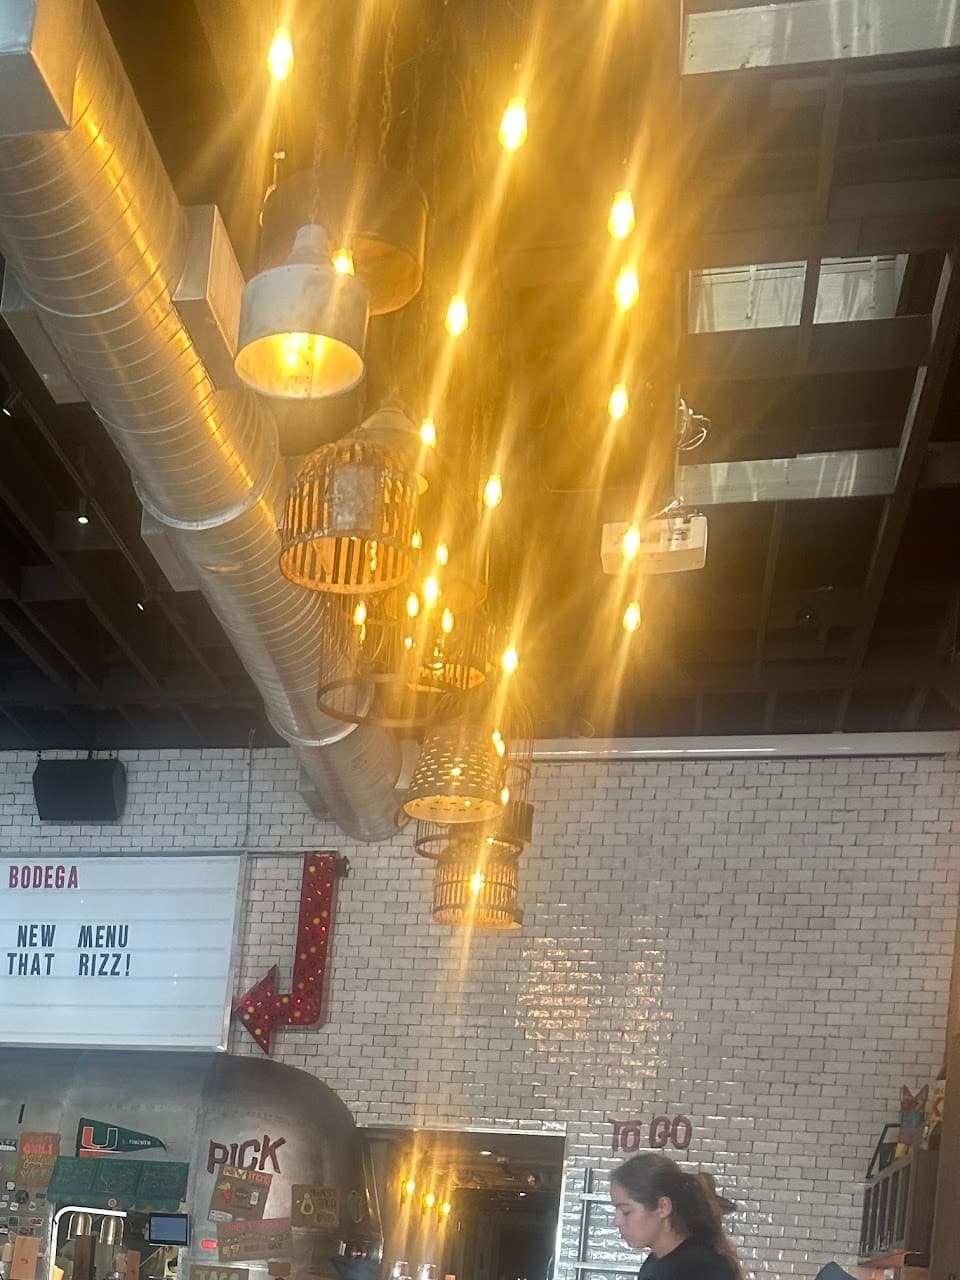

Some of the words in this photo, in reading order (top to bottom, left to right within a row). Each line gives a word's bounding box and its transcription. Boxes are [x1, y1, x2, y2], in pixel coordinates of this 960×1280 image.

[8, 864, 79, 889] BODEGA
[16, 924, 57, 948] NEW
[77, 924, 129, 949] MENU
[7, 952, 55, 976] THAT
[78, 953, 131, 977] RIZZ!
[608, 1117, 642, 1153] TO
[649, 1114, 693, 1149] GO
[206, 1134, 287, 1174] PICK
